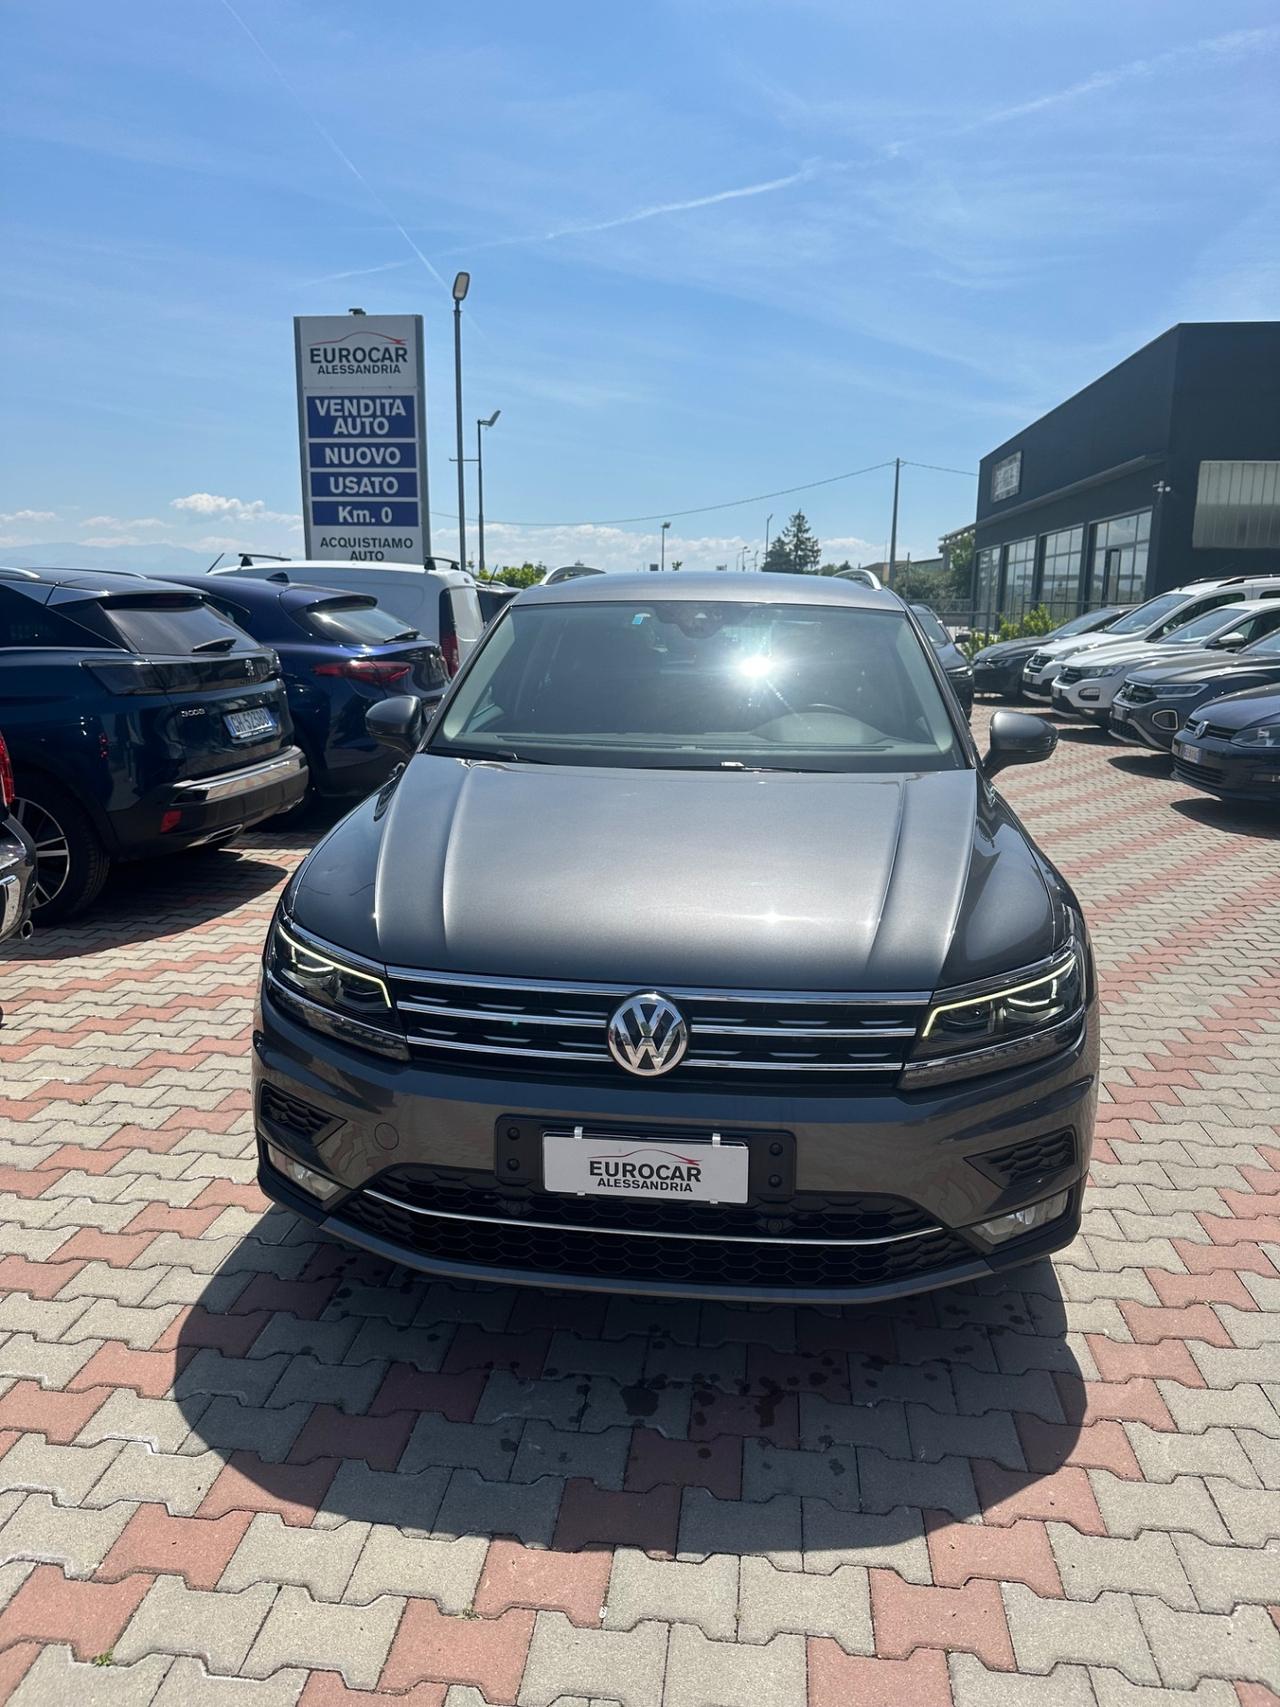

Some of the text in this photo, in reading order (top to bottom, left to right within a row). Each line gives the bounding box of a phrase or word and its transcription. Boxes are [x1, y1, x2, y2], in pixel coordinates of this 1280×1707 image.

[310, 347, 408, 364] EUROCAR
[317, 364, 402, 375] ALESSANDRIA
[315, 399, 407, 417] VENDITA
[333, 418, 390, 435] AUTO
[324, 447, 401, 465] NUOVO
[330, 476, 399, 494] USATO
[338, 506, 393, 523] Km. 0
[319, 537, 414, 549] ACQUISTIAMO
[350, 551, 385, 561] AUTO
[609, 994, 688, 1077] VW
[589, 1160, 702, 1183] EUROCAR
[597, 1177, 694, 1194] ALESSANDRIA
